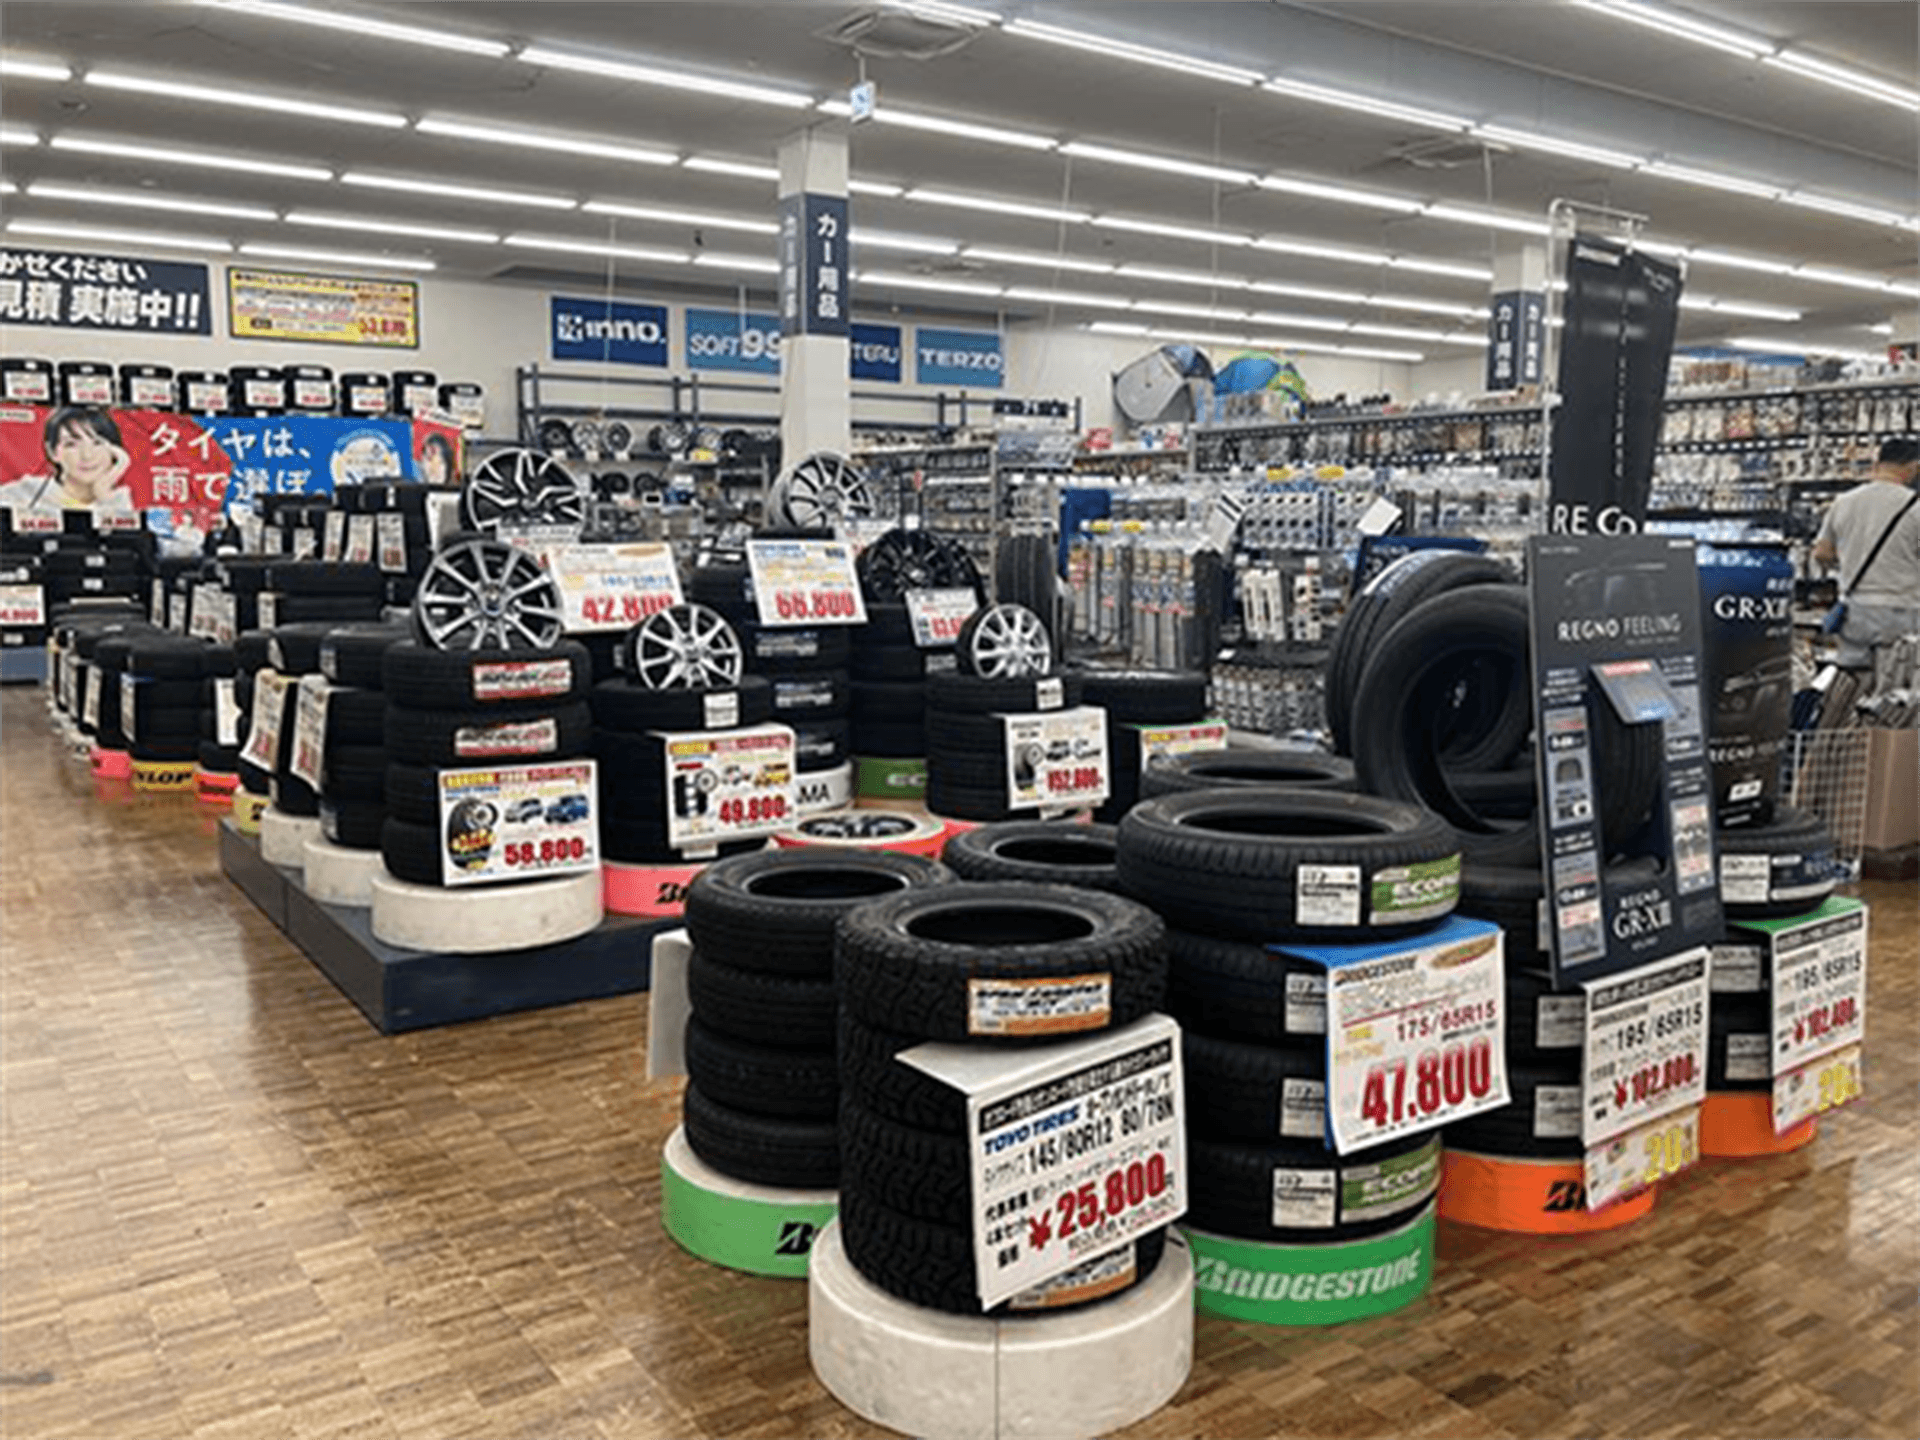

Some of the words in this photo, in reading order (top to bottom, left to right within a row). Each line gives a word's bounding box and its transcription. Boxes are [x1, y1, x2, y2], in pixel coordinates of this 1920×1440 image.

[817, 213, 840, 319] カー用品
[69, 284, 201, 329] 実施中!!
[150, 421, 312, 461] タイヤは、
[1557, 617, 1620, 642] REGNO
[1396, 1000, 1498, 1041] 175/65R15
[983, 1122, 1031, 1156] TOYO
[1032, 1104, 1081, 1137] TIRES
[1198, 1247, 1422, 1301] BRIDGESTONE
